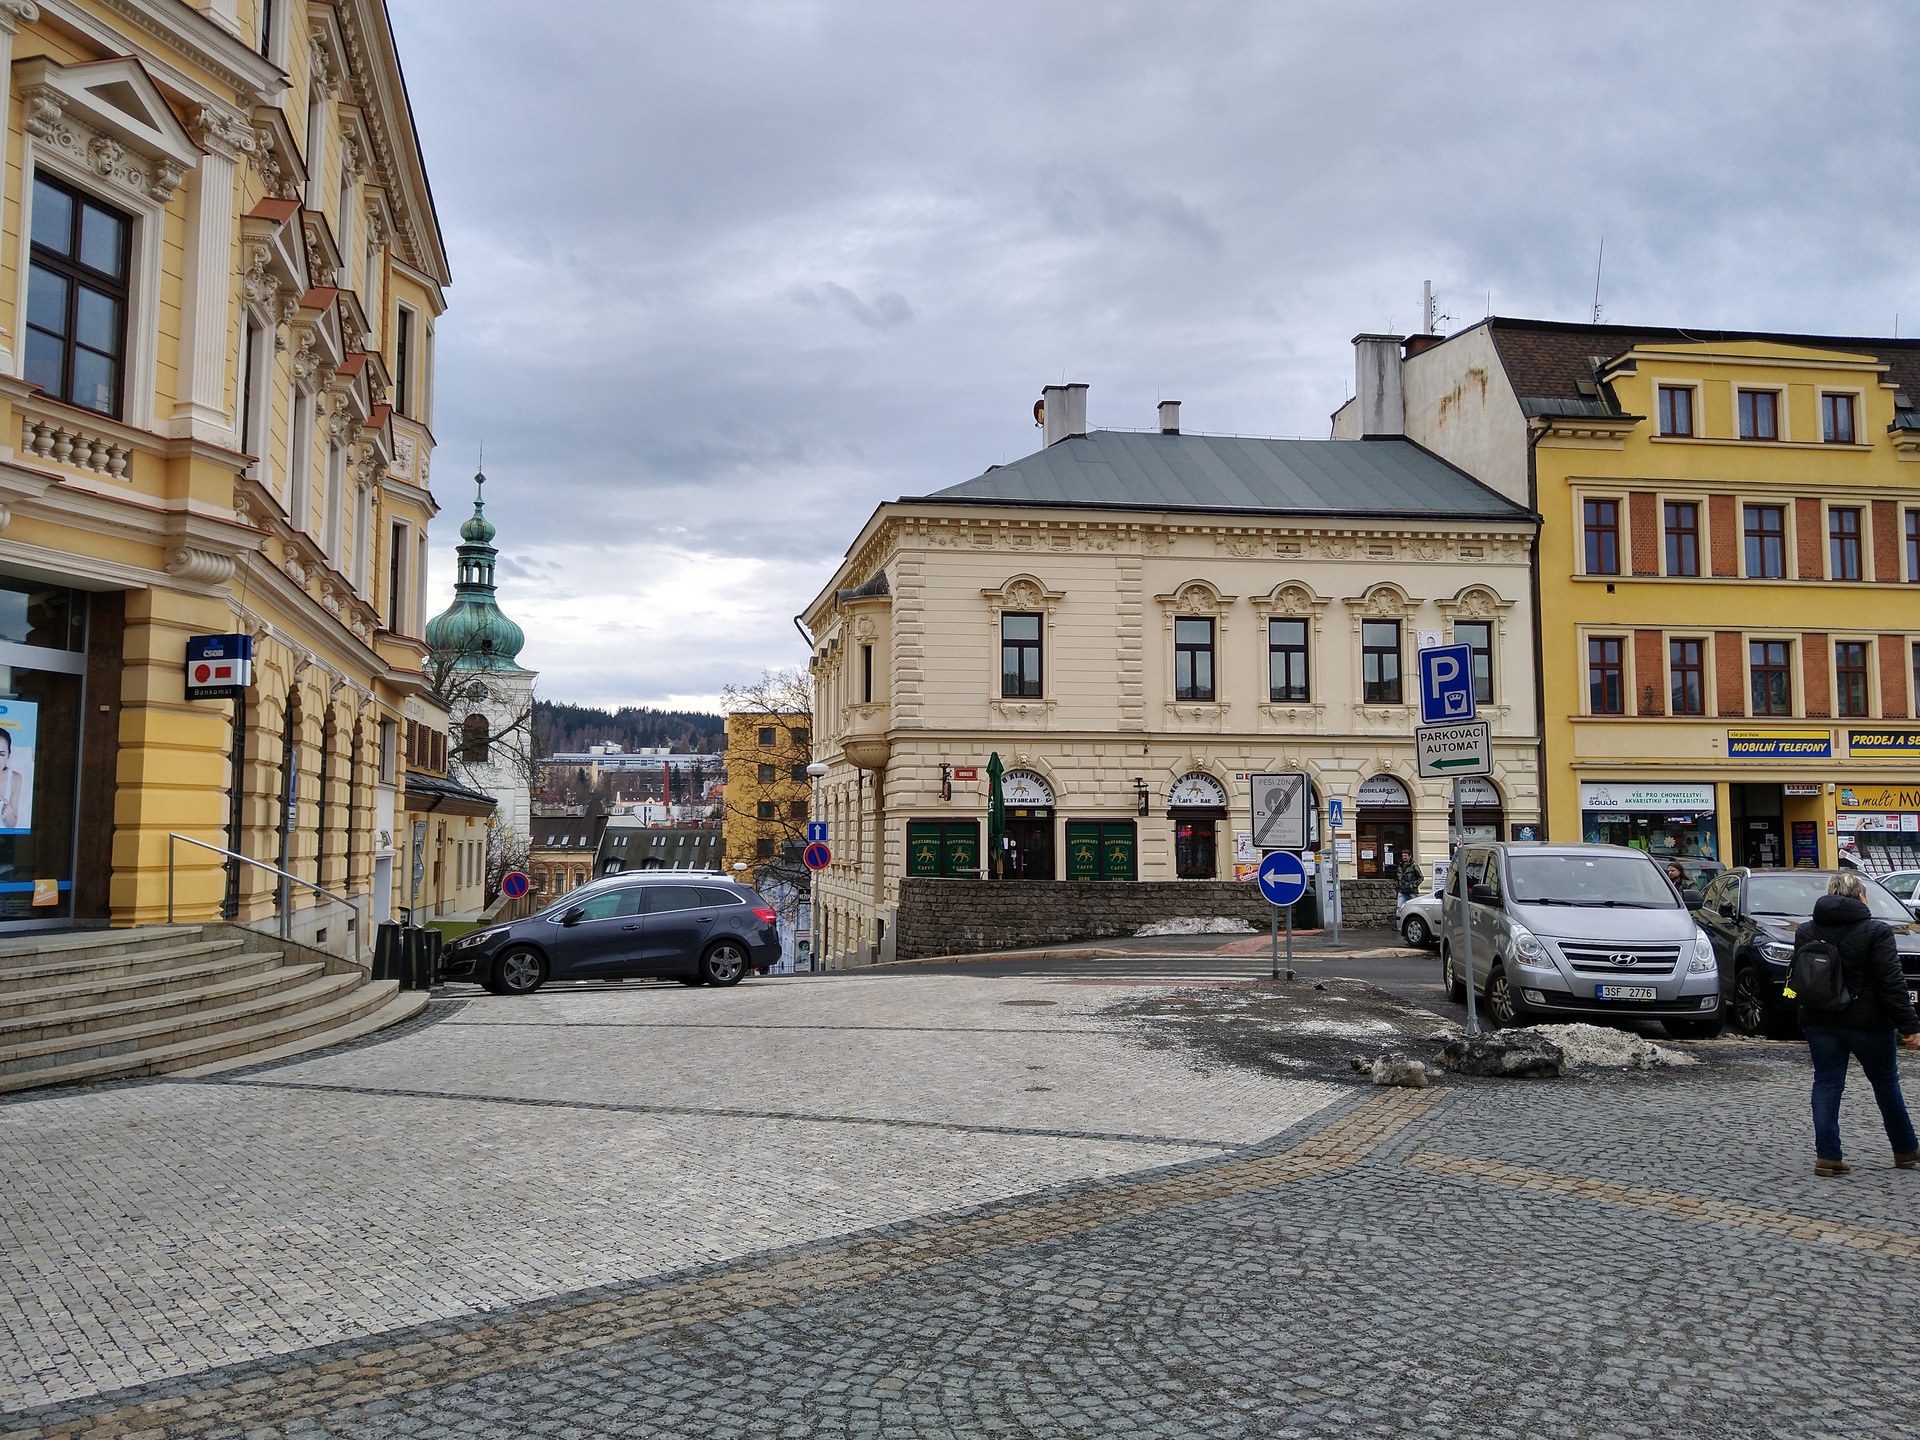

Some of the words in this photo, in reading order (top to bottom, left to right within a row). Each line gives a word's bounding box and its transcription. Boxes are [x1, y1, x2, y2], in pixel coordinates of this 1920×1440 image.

[1431, 656, 1460, 699] P
[194, 688, 232, 696] Bankomat
[1420, 725, 1484, 743] PARKOVACÍ
[1851, 734, 1895, 745] PRODEJ
[1895, 734, 1905, 745] A
[1426, 740, 1479, 754] AUTOMAT
[1732, 740, 1777, 752] MOBILNÍ
[1778, 743, 1828, 753] TELEFONY
[1660, 790, 1703, 798] CHOVATELSTVÍ
[1861, 790, 1897, 807] multi
[1605, 987, 1622, 997] 3SF
[1629, 988, 1652, 998] 2776
